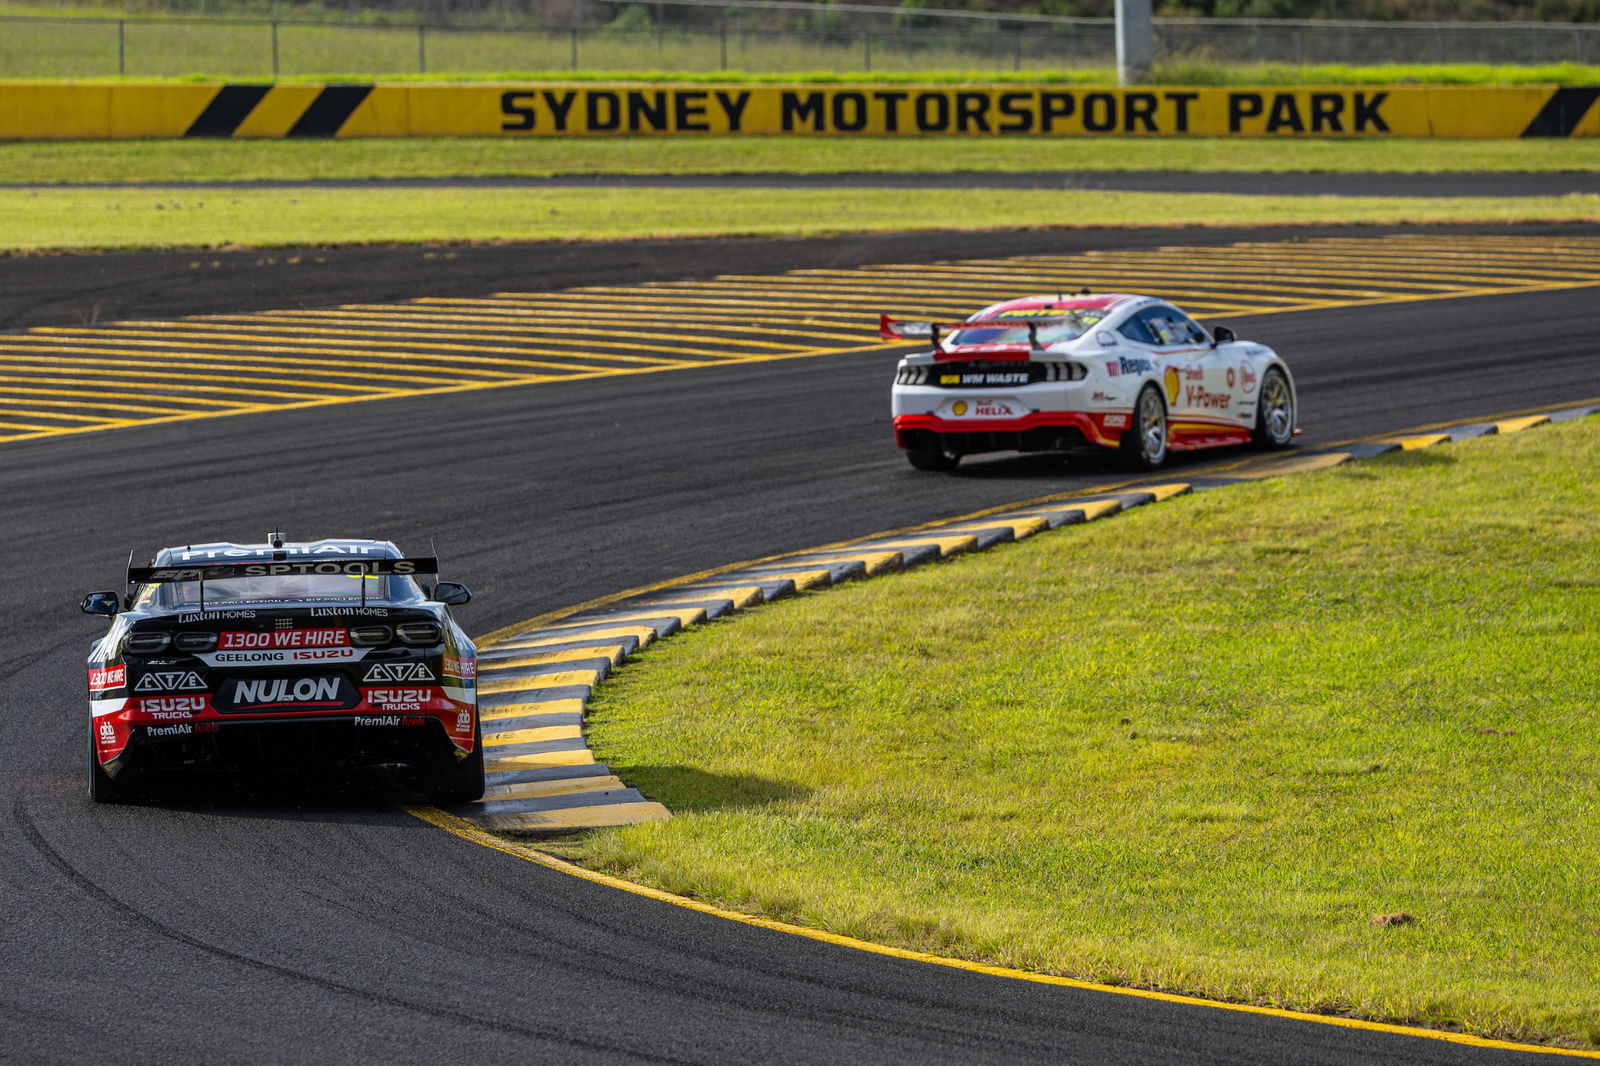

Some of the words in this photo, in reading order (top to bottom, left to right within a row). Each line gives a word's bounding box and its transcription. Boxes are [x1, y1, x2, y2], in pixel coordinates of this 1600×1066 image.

[501, 91, 752, 131] SYDNEY
[781, 91, 1198, 133] MOTORSPORT
[1229, 92, 1391, 133] PARK
[962, 374, 984, 384] WM
[985, 373, 1029, 384] WASTE
[1186, 385, 1231, 409] V-Power
[976, 406, 1013, 416] HELIX
[178, 612, 220, 624] Luxton
[222, 610, 256, 619] HOMES
[310, 606, 354, 617] Luxton
[355, 607, 389, 617] HOMES
[224, 633, 270, 648] 1300
[274, 632, 301, 646] WE
[304, 630, 345, 645] HIRE
[215, 653, 284, 662] GEELONG
[293, 649, 353, 660] ISUZU
[233, 677, 340, 704] NULON
[367, 689, 431, 704] ISUZU
[141, 697, 206, 713] ISUZU
[382, 702, 421, 711] TRUCKS
[152, 711, 193, 720] TRUCKS
[354, 715, 400, 727] PremiAir
[147, 723, 193, 736] PremiAir
